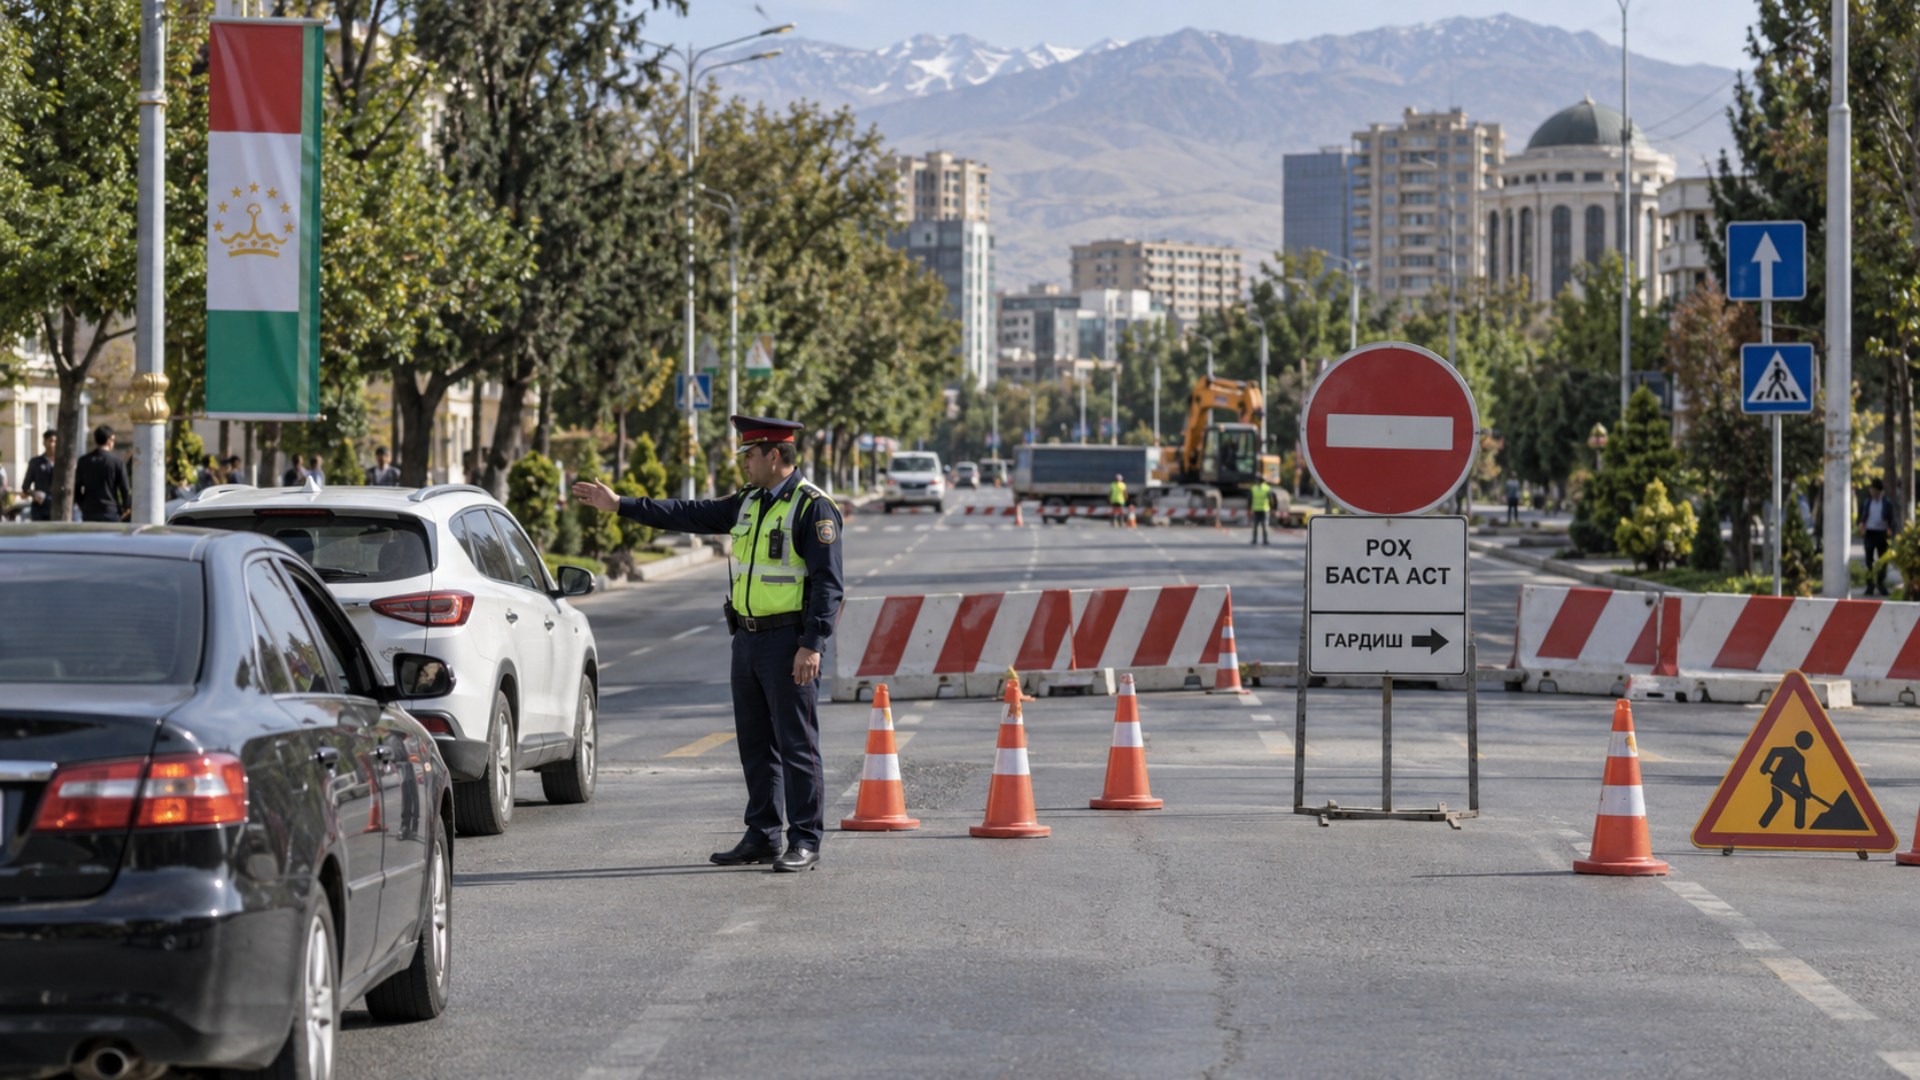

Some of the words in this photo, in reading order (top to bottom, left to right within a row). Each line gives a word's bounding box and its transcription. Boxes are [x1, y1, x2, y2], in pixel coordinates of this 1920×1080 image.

[1366, 539, 1412, 560] РОҲ
[1325, 566, 1400, 585] БАСТА
[1405, 566, 1451, 585] АСТ
[1325, 633, 1403, 651] ГАРДИШ
